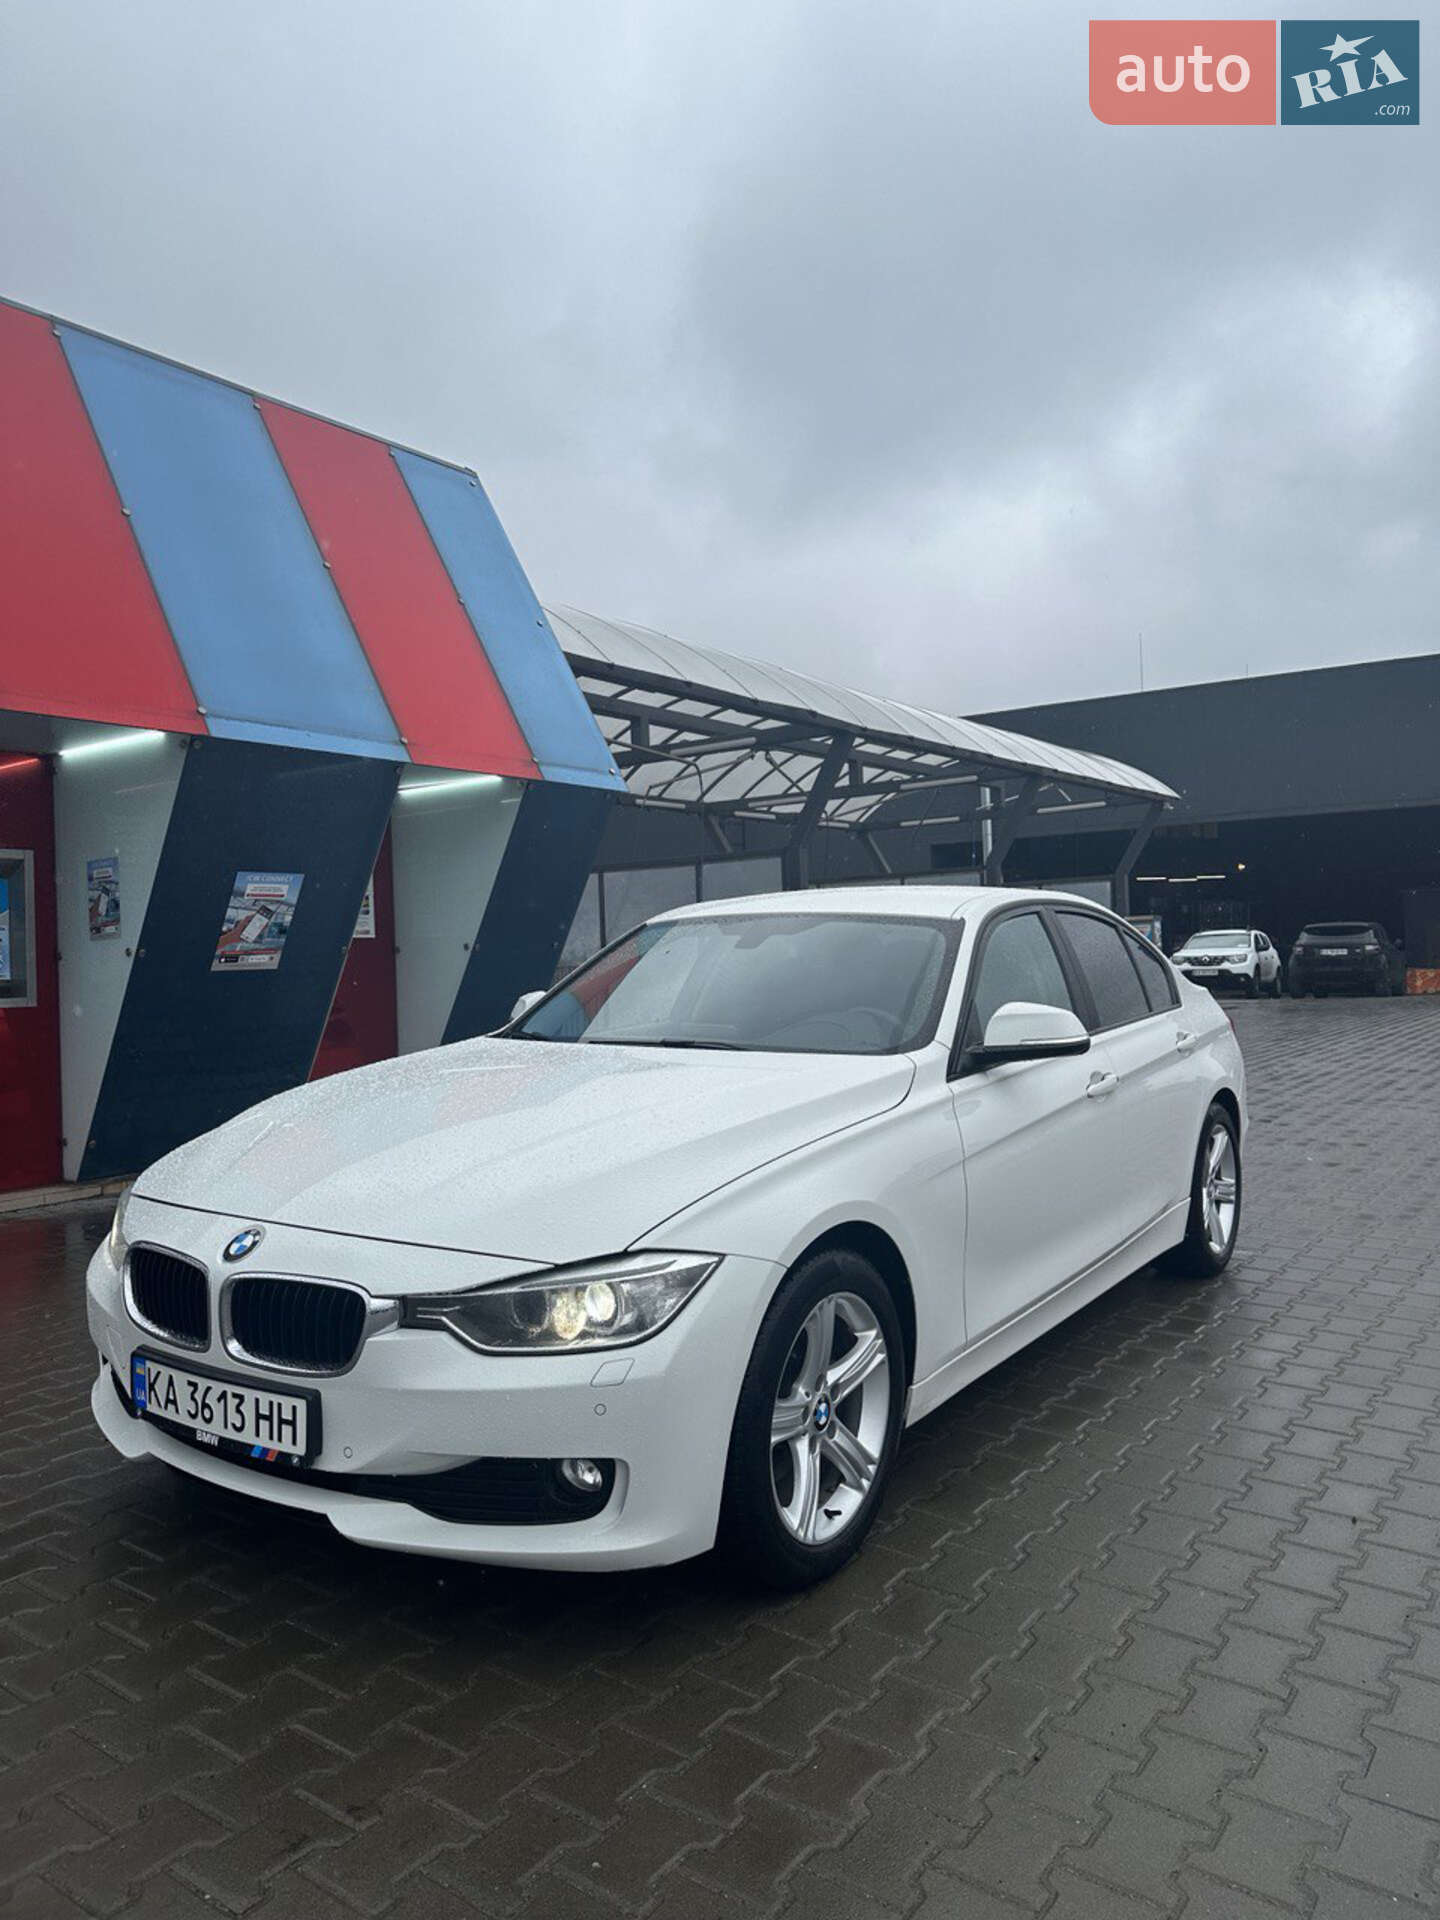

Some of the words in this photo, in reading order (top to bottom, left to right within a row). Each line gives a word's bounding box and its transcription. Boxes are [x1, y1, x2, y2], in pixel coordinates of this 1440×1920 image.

[148, 1367, 180, 1415] KA
[186, 1379, 245, 1433] 3613
[254, 1397, 298, 1447] HH
[196, 1430, 219, 1446] BMW
